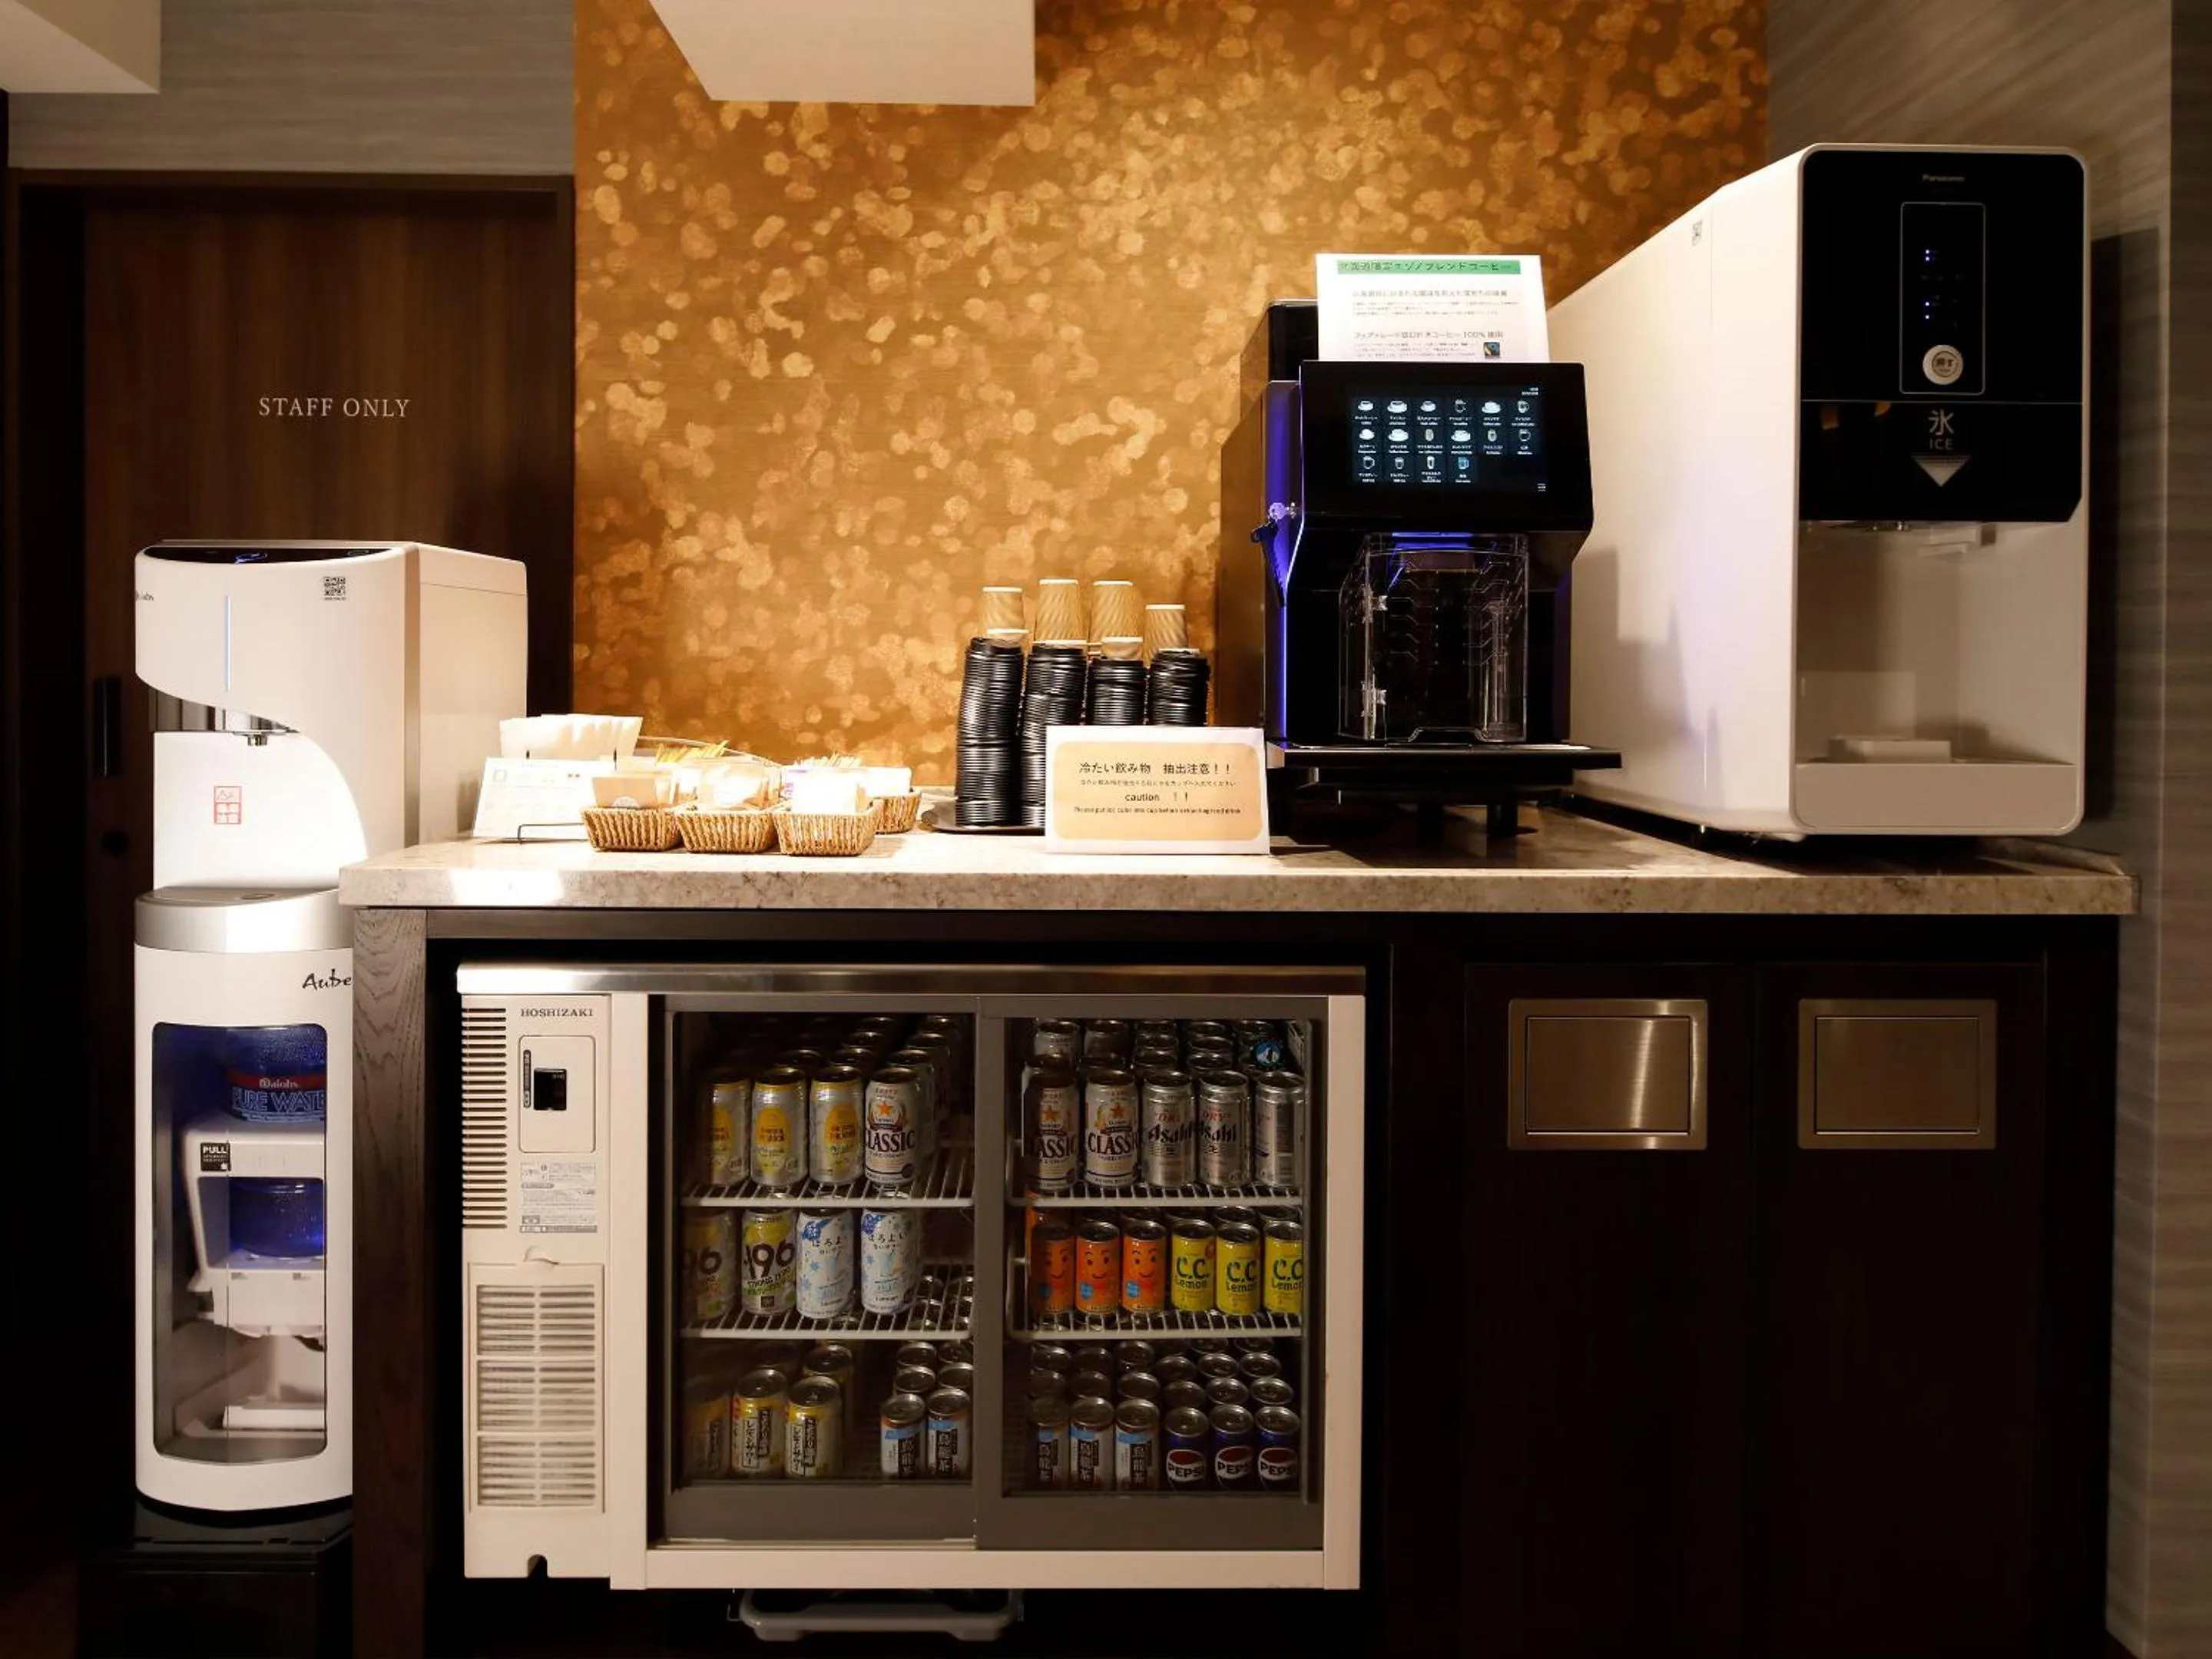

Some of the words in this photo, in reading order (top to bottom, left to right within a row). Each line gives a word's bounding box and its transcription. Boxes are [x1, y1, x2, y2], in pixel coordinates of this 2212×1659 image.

[258, 397, 333, 416] STAFF
[343, 398, 411, 417] ONLY
[1928, 409, 1955, 435] 氷
[1929, 438, 1954, 450] ICE
[1079, 763, 1151, 774] 冷たい飲み物
[1124, 793, 1160, 802] caution
[520, 1008, 594, 1017] HOSHIZAKI
[270, 1089, 326, 1111] WATE
[865, 1130, 916, 1153] LASSIC
[203, 1145, 227, 1154] PULL
[812, 1236, 844, 1248] ほろよ
